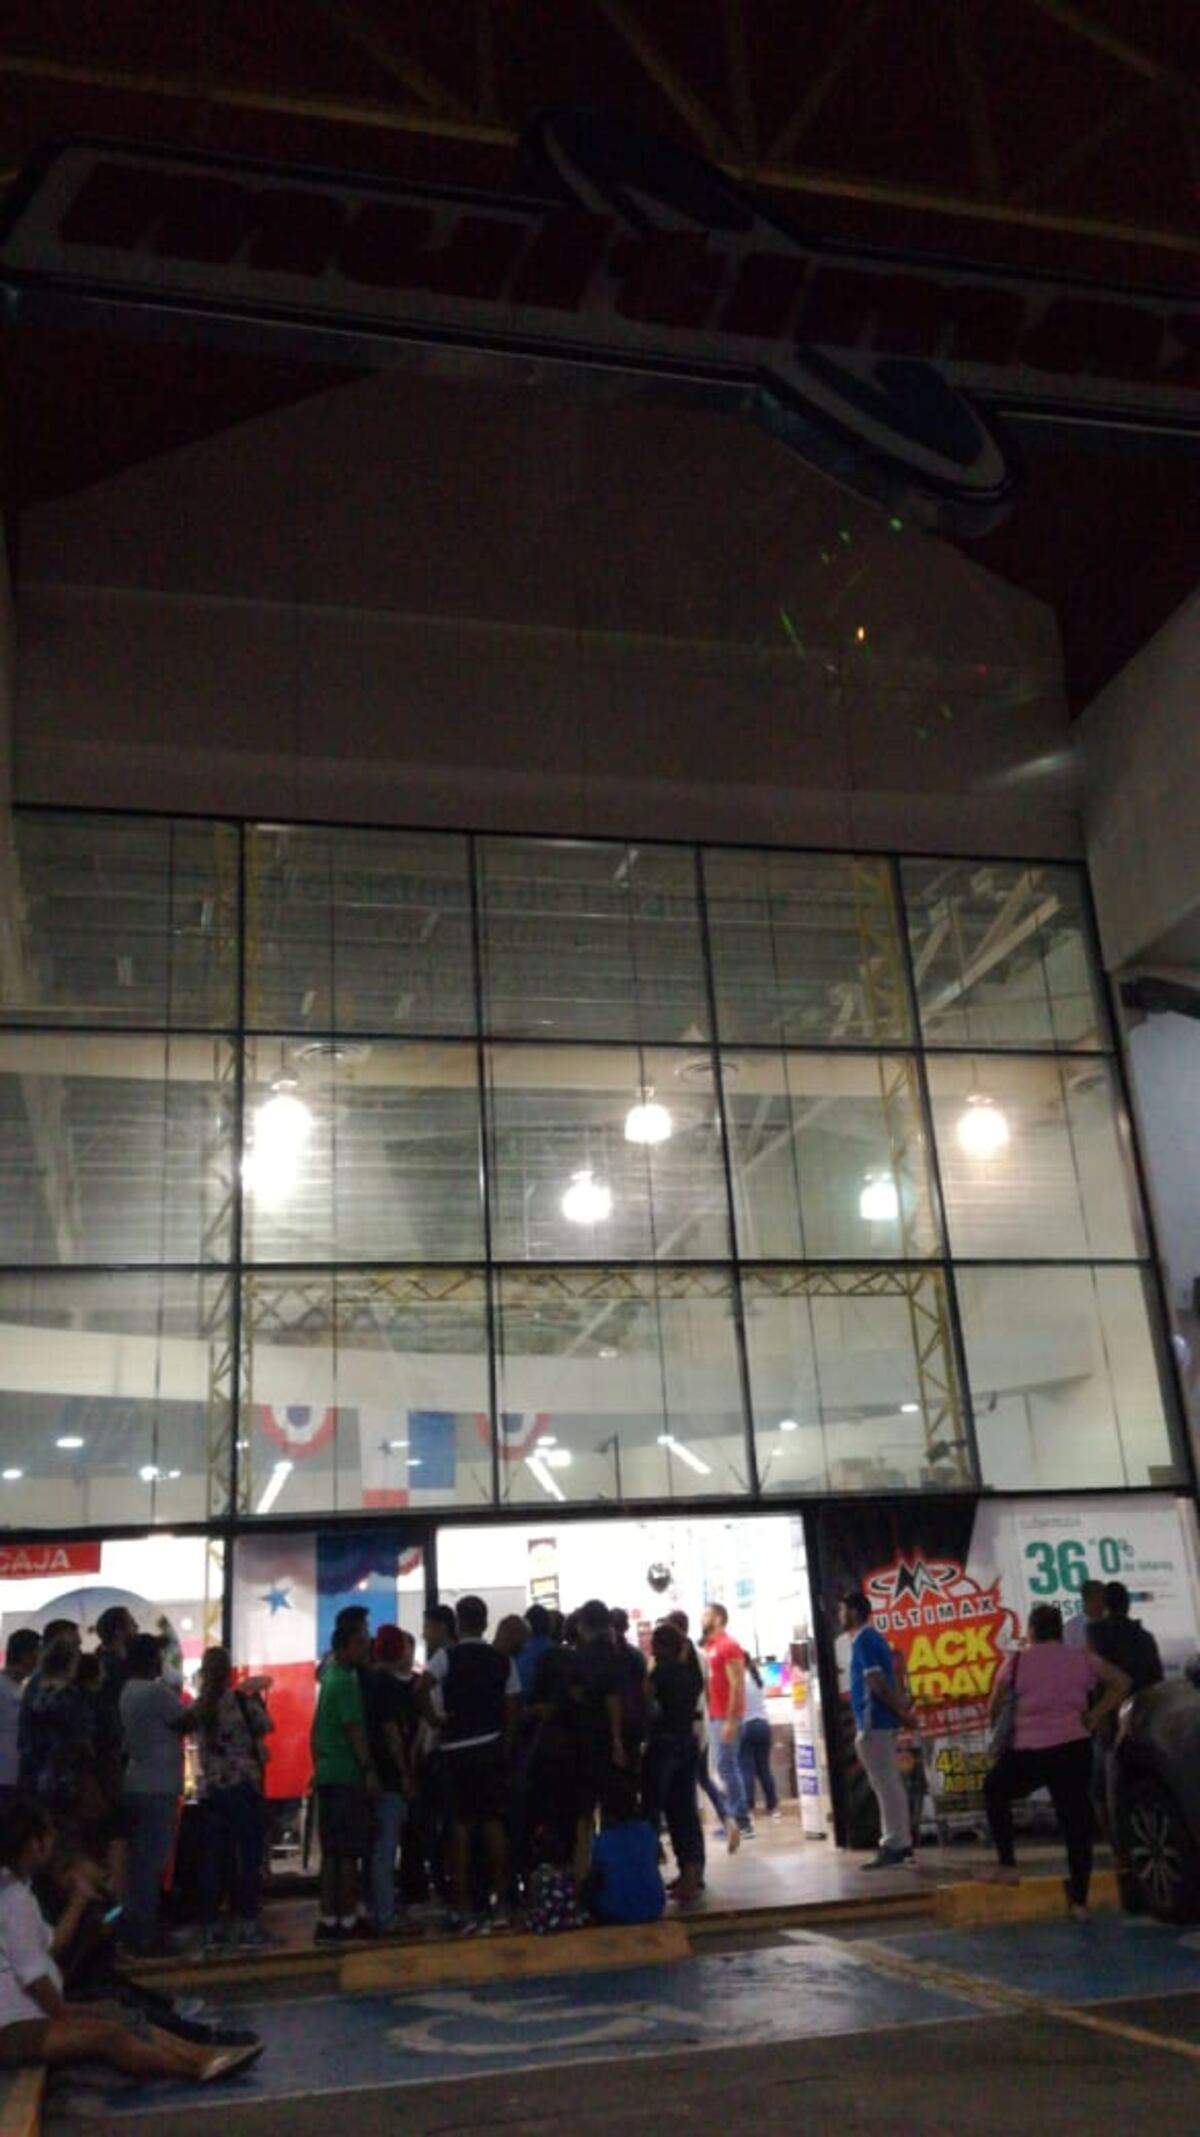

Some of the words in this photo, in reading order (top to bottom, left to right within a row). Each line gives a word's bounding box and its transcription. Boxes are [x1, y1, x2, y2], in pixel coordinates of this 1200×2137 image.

[1025, 1540, 1089, 1595] 36
[874, 1596, 995, 1631] ULTIMAX
[907, 1624, 996, 1672] ACK
